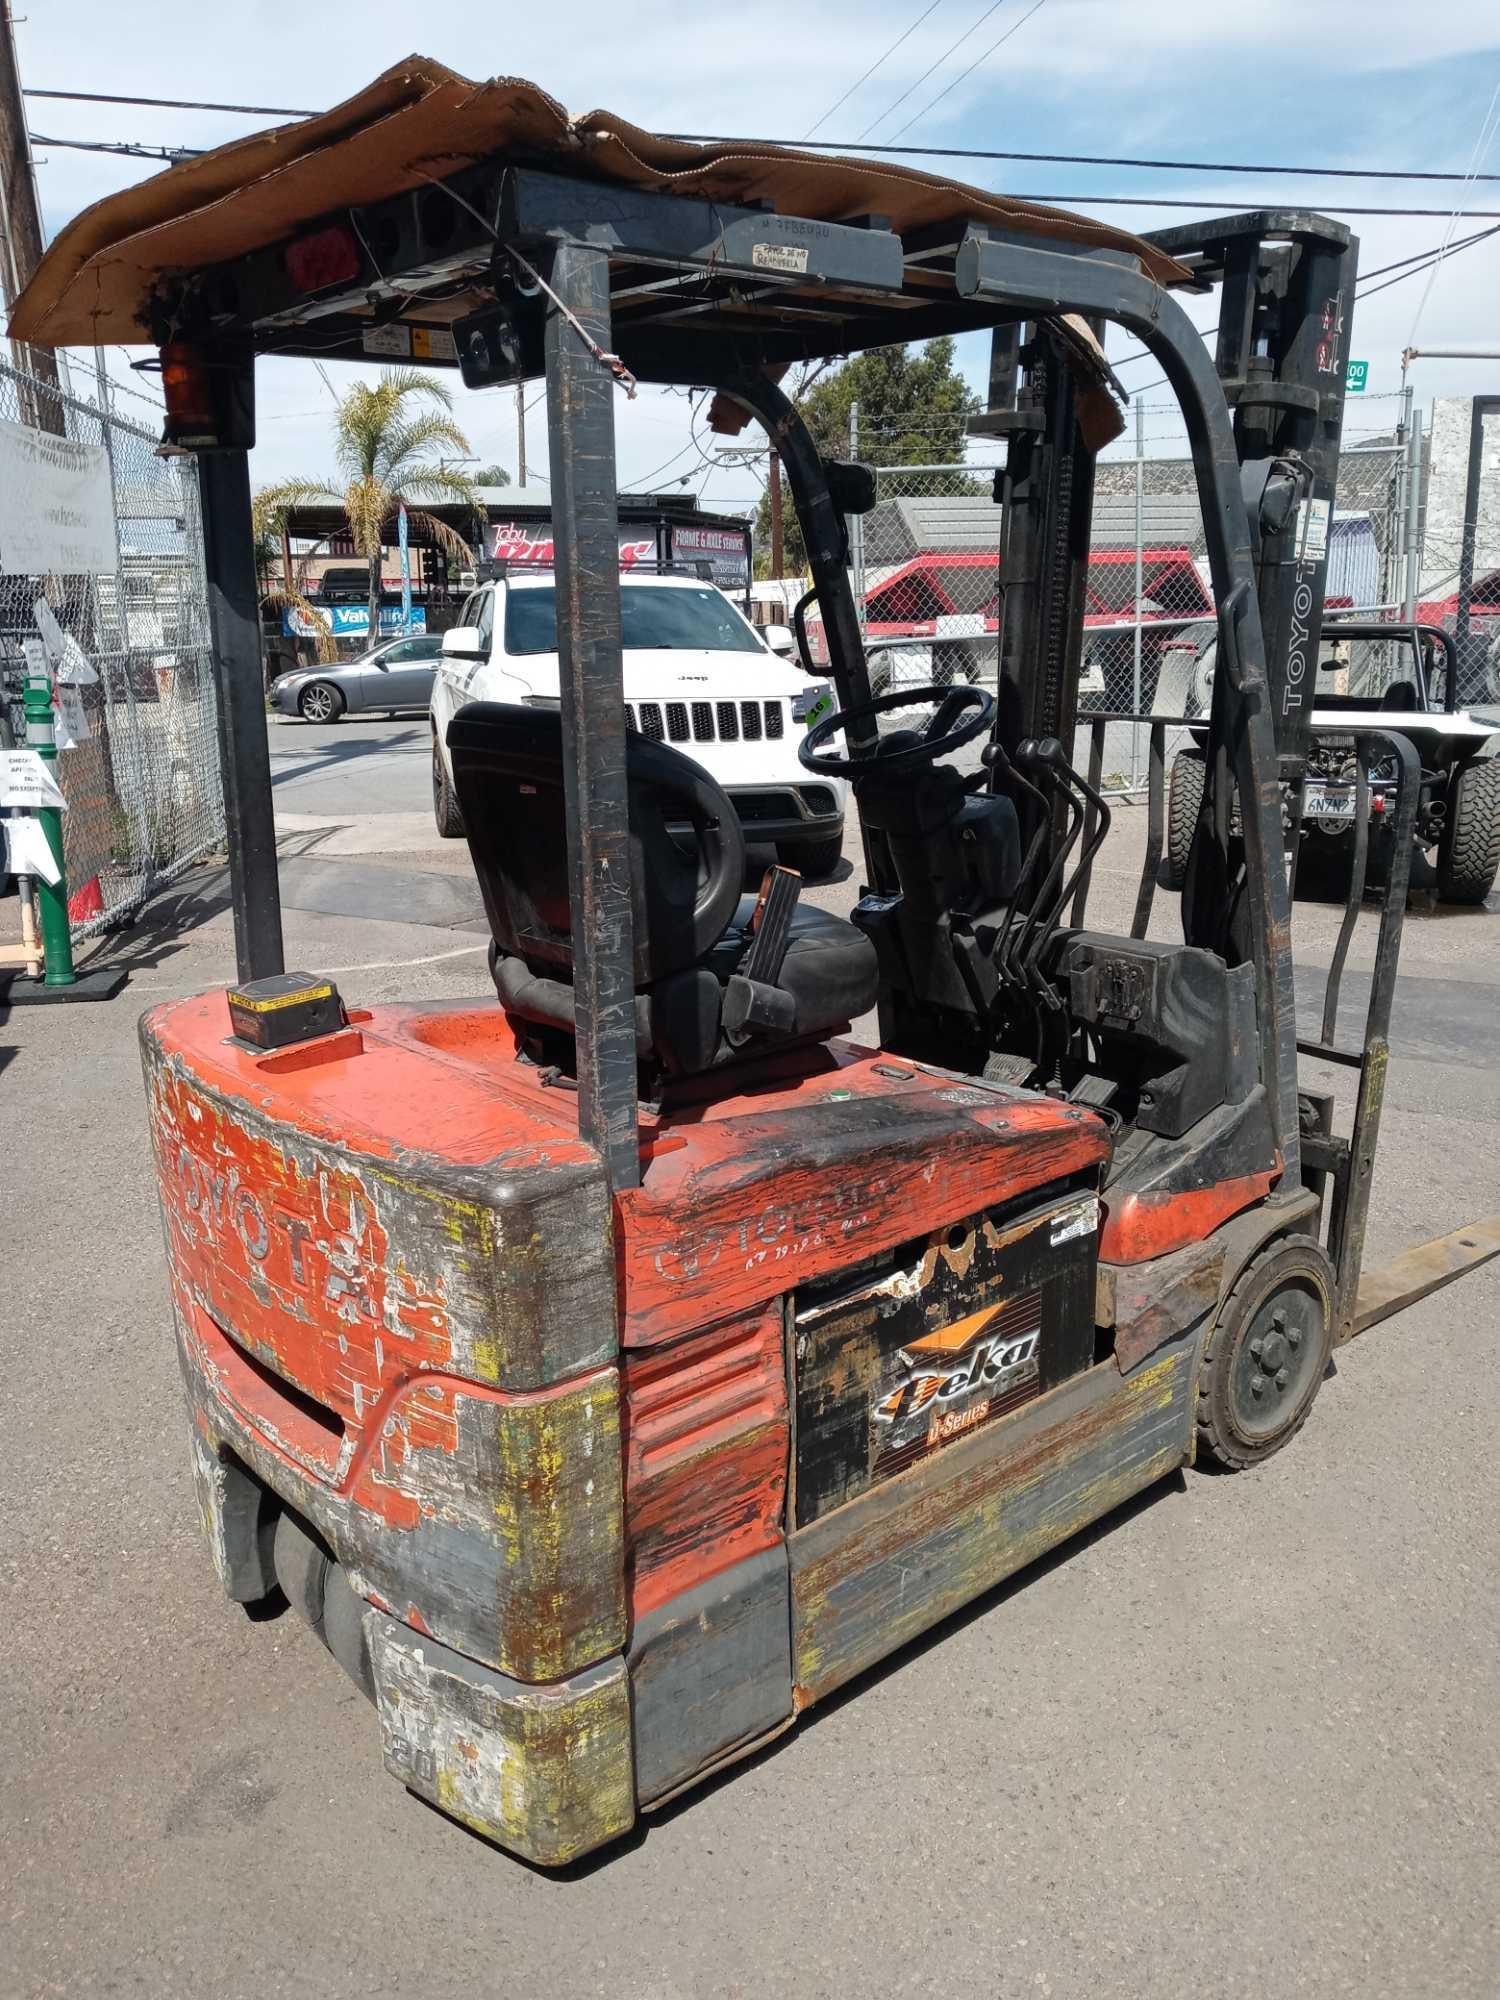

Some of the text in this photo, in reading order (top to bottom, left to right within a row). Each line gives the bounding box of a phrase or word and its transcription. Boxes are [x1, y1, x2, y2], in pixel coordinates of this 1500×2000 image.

[1347, 365, 1365, 377] 00
[492, 522, 527, 545] Toby
[675, 530, 699, 547] FRAME
[1282, 556, 1317, 715] TOYOT
[875, 1337, 1036, 1423] Deka
